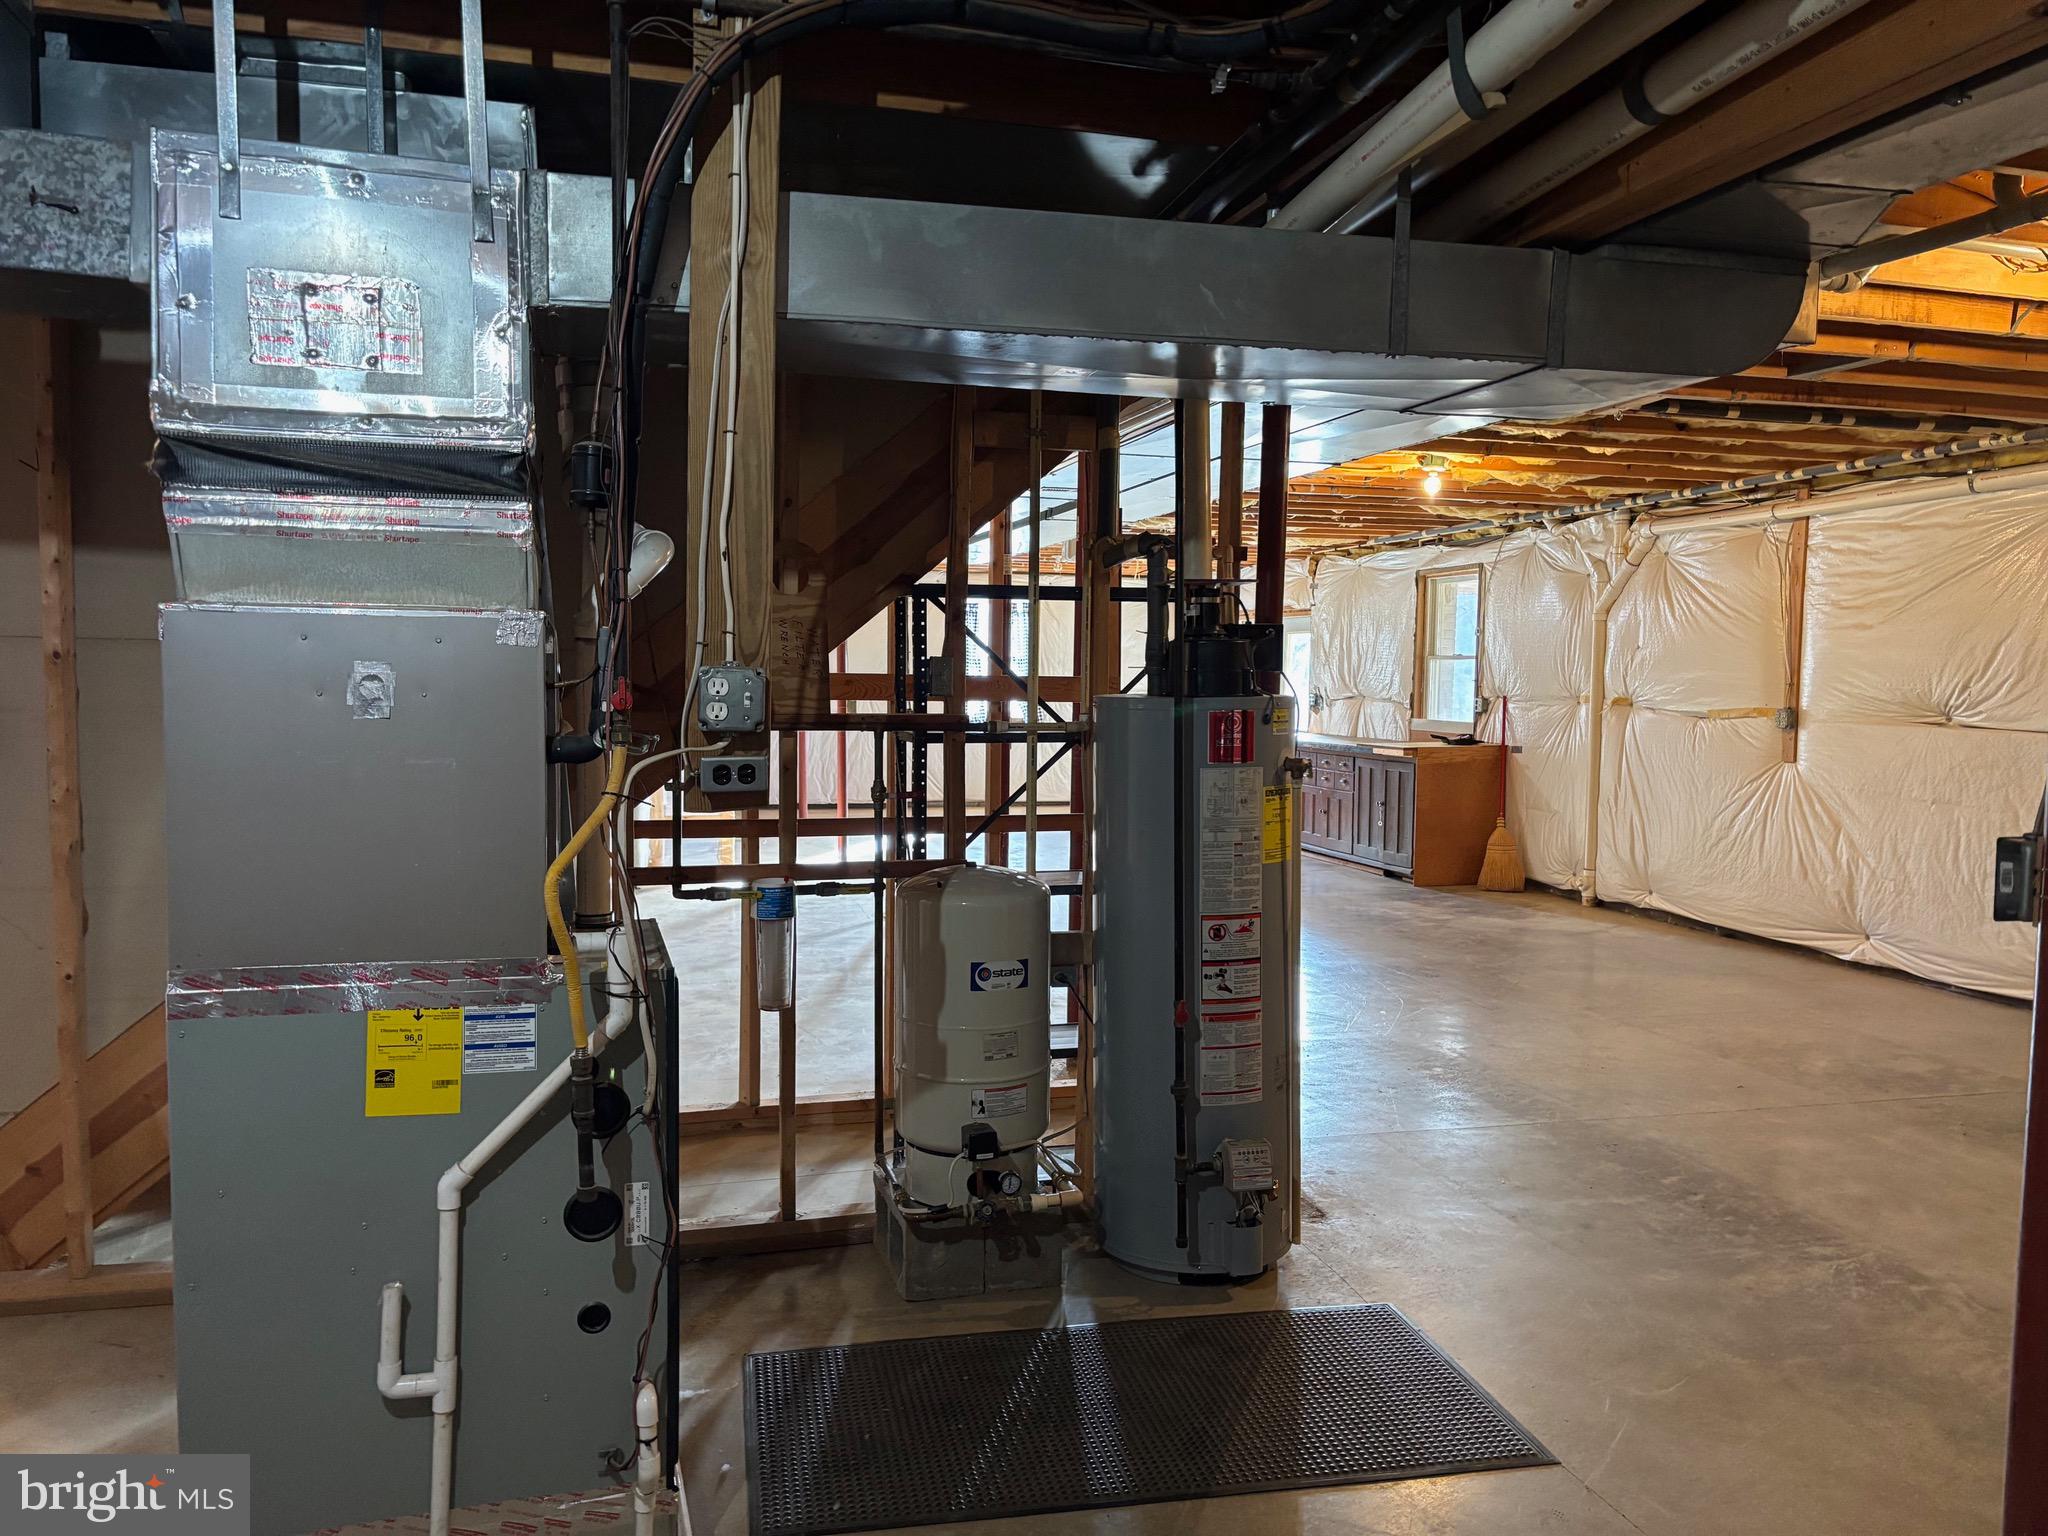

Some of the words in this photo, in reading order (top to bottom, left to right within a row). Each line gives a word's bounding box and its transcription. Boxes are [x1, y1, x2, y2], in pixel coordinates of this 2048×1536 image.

[276, 511, 314, 520] Shurtape
[384, 516, 420, 526] Shurtape
[276, 530, 313, 539] Shurtape
[384, 534, 419, 543] Shurtape
[779, 618, 790, 665] WRENCH
[992, 967, 1024, 978] state
[404, 1034, 423, 1042] 96.0
